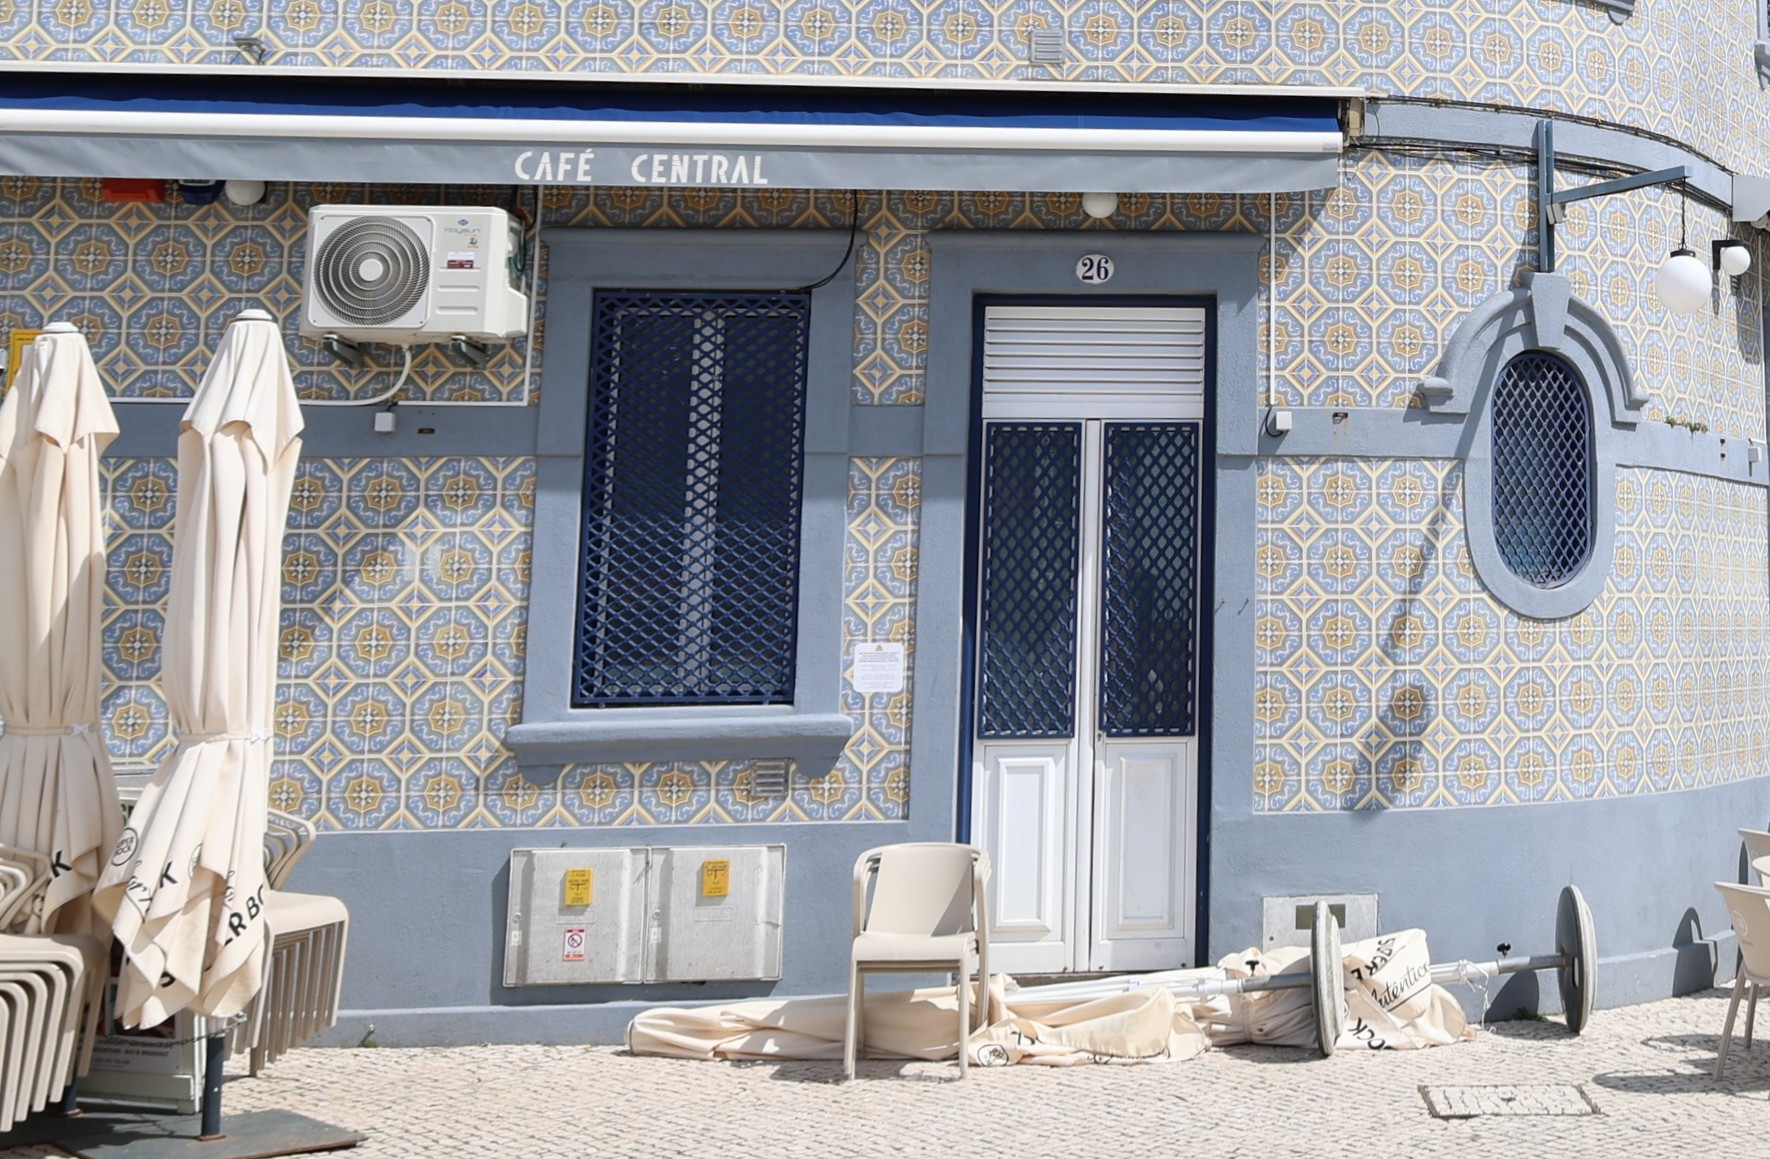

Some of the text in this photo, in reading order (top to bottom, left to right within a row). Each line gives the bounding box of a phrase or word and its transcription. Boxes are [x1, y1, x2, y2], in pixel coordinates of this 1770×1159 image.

[514, 148, 769, 185] CAFÉ CENTRAL
[1081, 256, 1109, 281] 26
